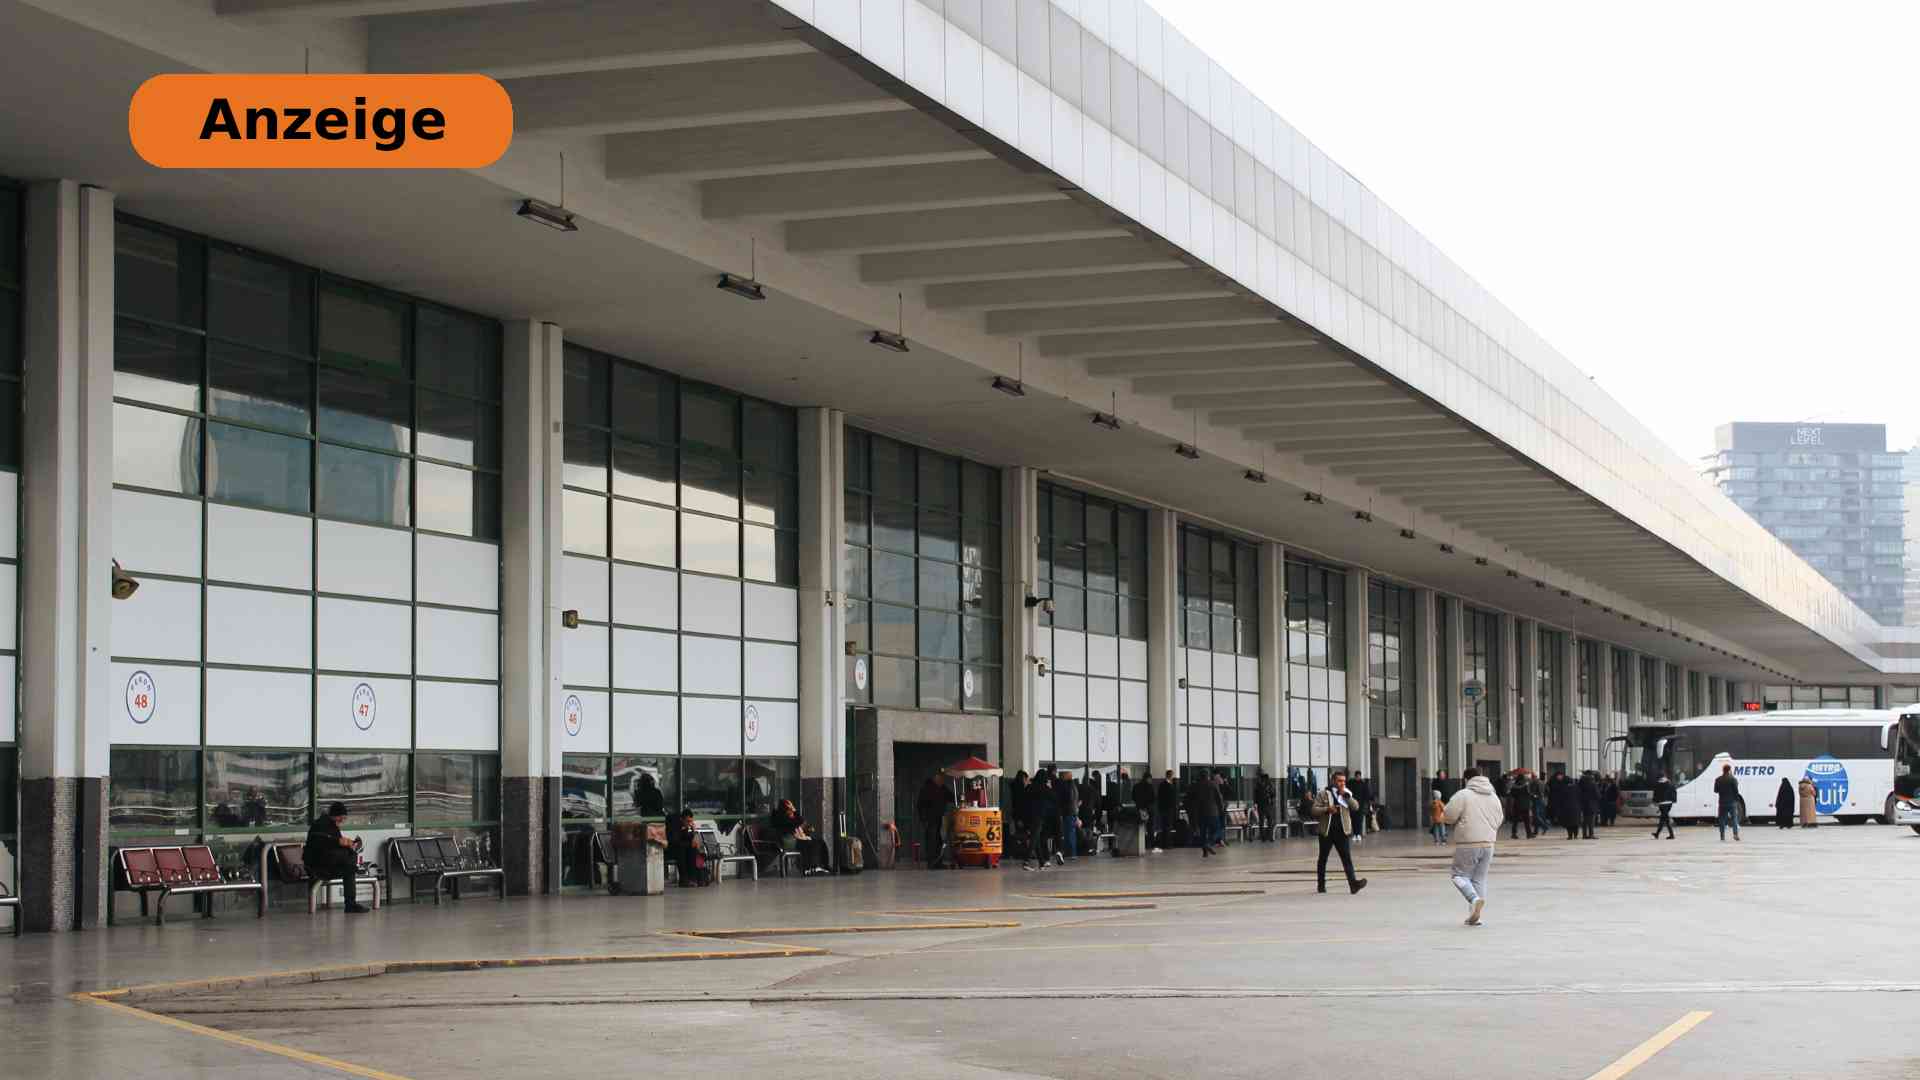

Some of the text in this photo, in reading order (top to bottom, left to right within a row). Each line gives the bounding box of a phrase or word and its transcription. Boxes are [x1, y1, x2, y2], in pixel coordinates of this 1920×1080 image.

[134, 693, 148, 709] 48
[359, 703, 369, 717] 47
[1733, 765, 1775, 776] METRO
